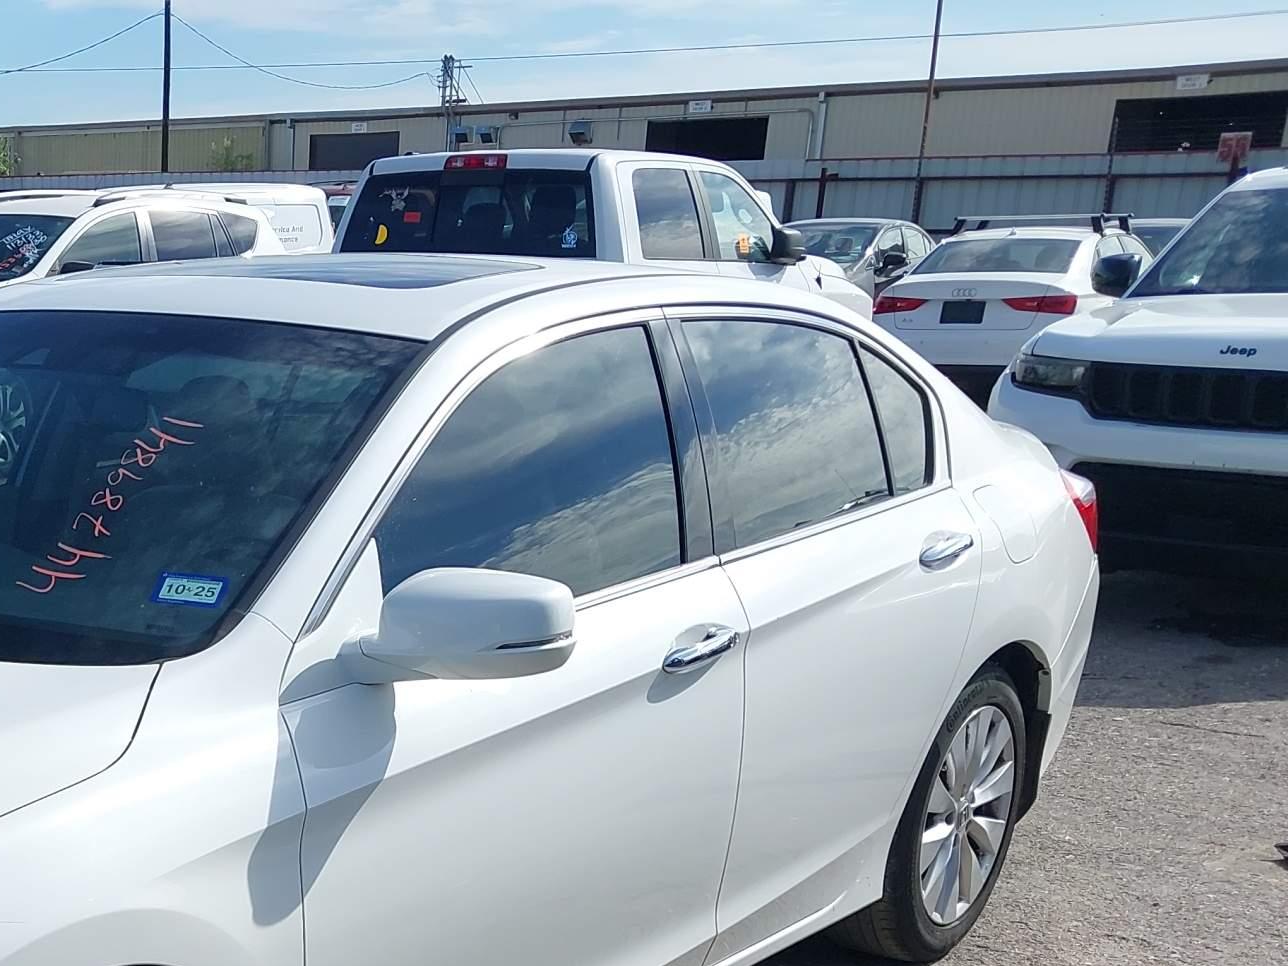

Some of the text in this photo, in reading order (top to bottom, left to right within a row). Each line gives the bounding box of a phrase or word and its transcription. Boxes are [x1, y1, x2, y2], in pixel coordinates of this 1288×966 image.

[1219, 345, 1258, 358] Jeep
[15, 416, 204, 593] 44789841
[166, 584, 217, 598] 10 25
